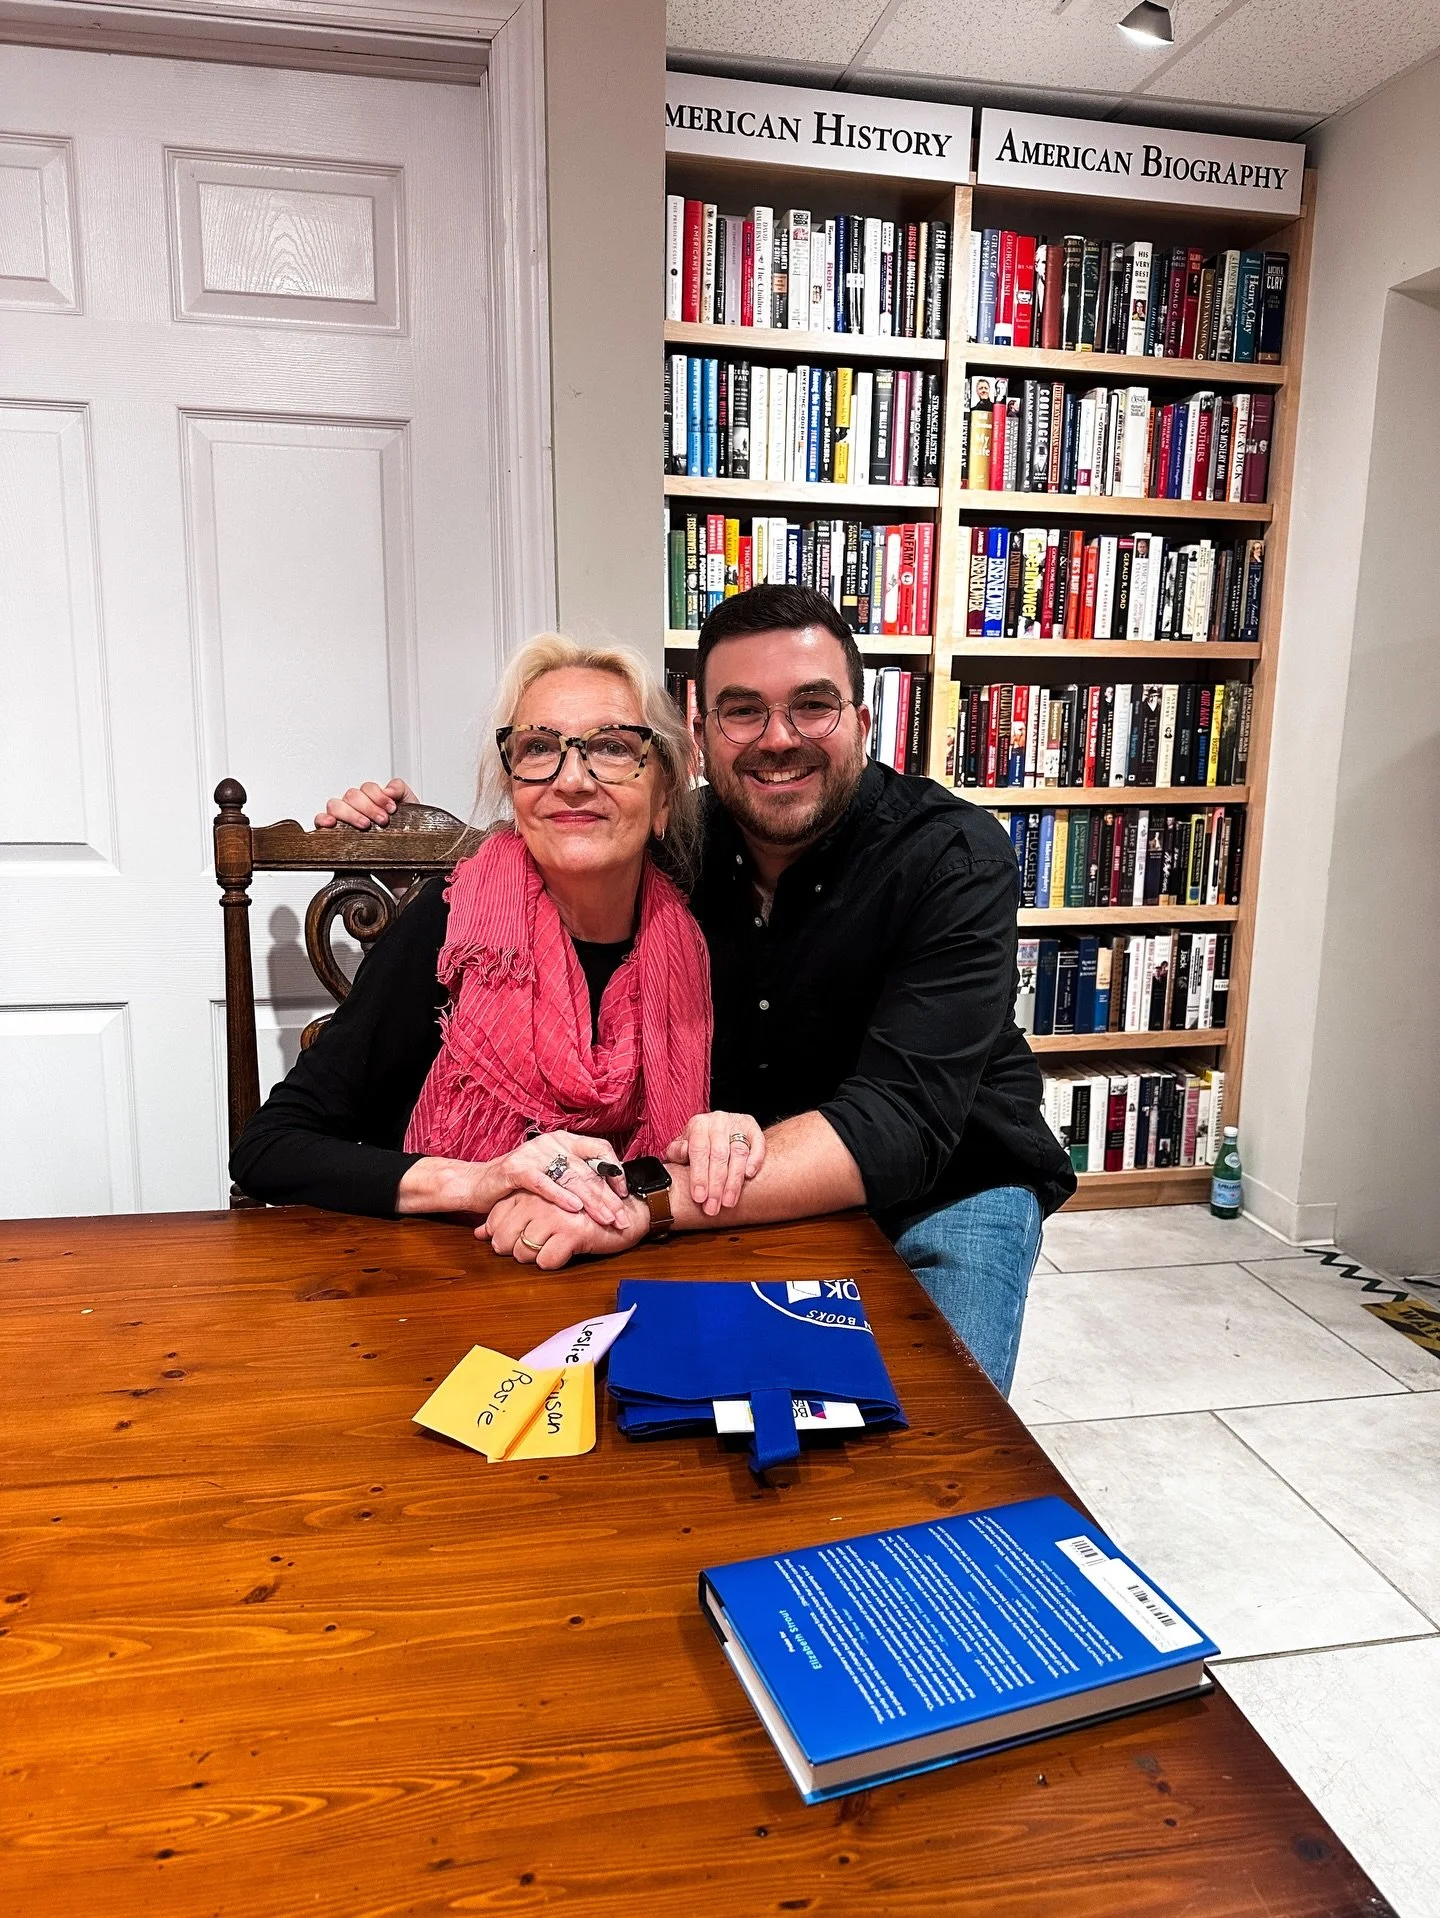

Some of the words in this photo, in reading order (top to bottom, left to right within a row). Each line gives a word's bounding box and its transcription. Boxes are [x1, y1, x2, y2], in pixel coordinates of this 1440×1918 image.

[665, 103, 802, 143] MERICAN
[812, 110, 953, 158] HISTORY
[995, 127, 1134, 176] AMERICAN
[1140, 144, 1290, 190] BIOGRAPHY
[908, 226, 916, 260] RUSSIAN
[936, 230, 946, 249] FEAR
[935, 253, 945, 279] ITSELF
[982, 240, 990, 272] STEEL
[1136, 260, 1150, 268] VERY
[1172, 278, 1180, 308] RONALD
[1244, 275, 1258, 308] Henry
[1266, 275, 1283, 289] CLAY
[1244, 310, 1257, 334] Clay
[931, 395, 939, 432] STRANGE
[1027, 411, 1033, 423] OF
[1038, 389, 1050, 443] COOLIDGE
[1221, 416, 1230, 433] IKE'S
[1238, 418, 1246, 438] IKE
[929, 434, 937, 464] JUSTICE
[1197, 416, 1208, 462] BROTHERS
[1218, 435, 1229, 463] MYSTERY
[1237, 440, 1244, 448] &
[1217, 465, 1226, 480] MAN
[1234, 451, 1244, 480] DICK
[903, 530, 914, 567] INFAMY
[1022, 539, 1046, 619] Eisenhower
[1122, 553, 1130, 580] GERALD
[968, 555, 987, 612] EISENHOWER
[985, 558, 1005, 622] EISENHOWER
[998, 687, 1012, 737] GOLDWATER
[1201, 690, 1211, 707] OUR
[1092, 709, 1098, 720] Of
[1148, 718, 1157, 737] The
[1200, 708, 1209, 727] MAN
[912, 716, 920, 754] ASCENDANT
[1147, 739, 1156, 763] Chief
[1128, 824, 1137, 846] Jesse
[1028, 831, 1038, 888] HUGHES
[1041, 863, 1051, 893] Humphrey
[806, 1309, 856, 1326] BOOKS
[565, 1321, 604, 1364] Leslie
[476, 1369, 534, 1428] Rosie
[779, 1610, 798, 1632] Strout
[795, 1634, 822, 1669] Elizabeth
